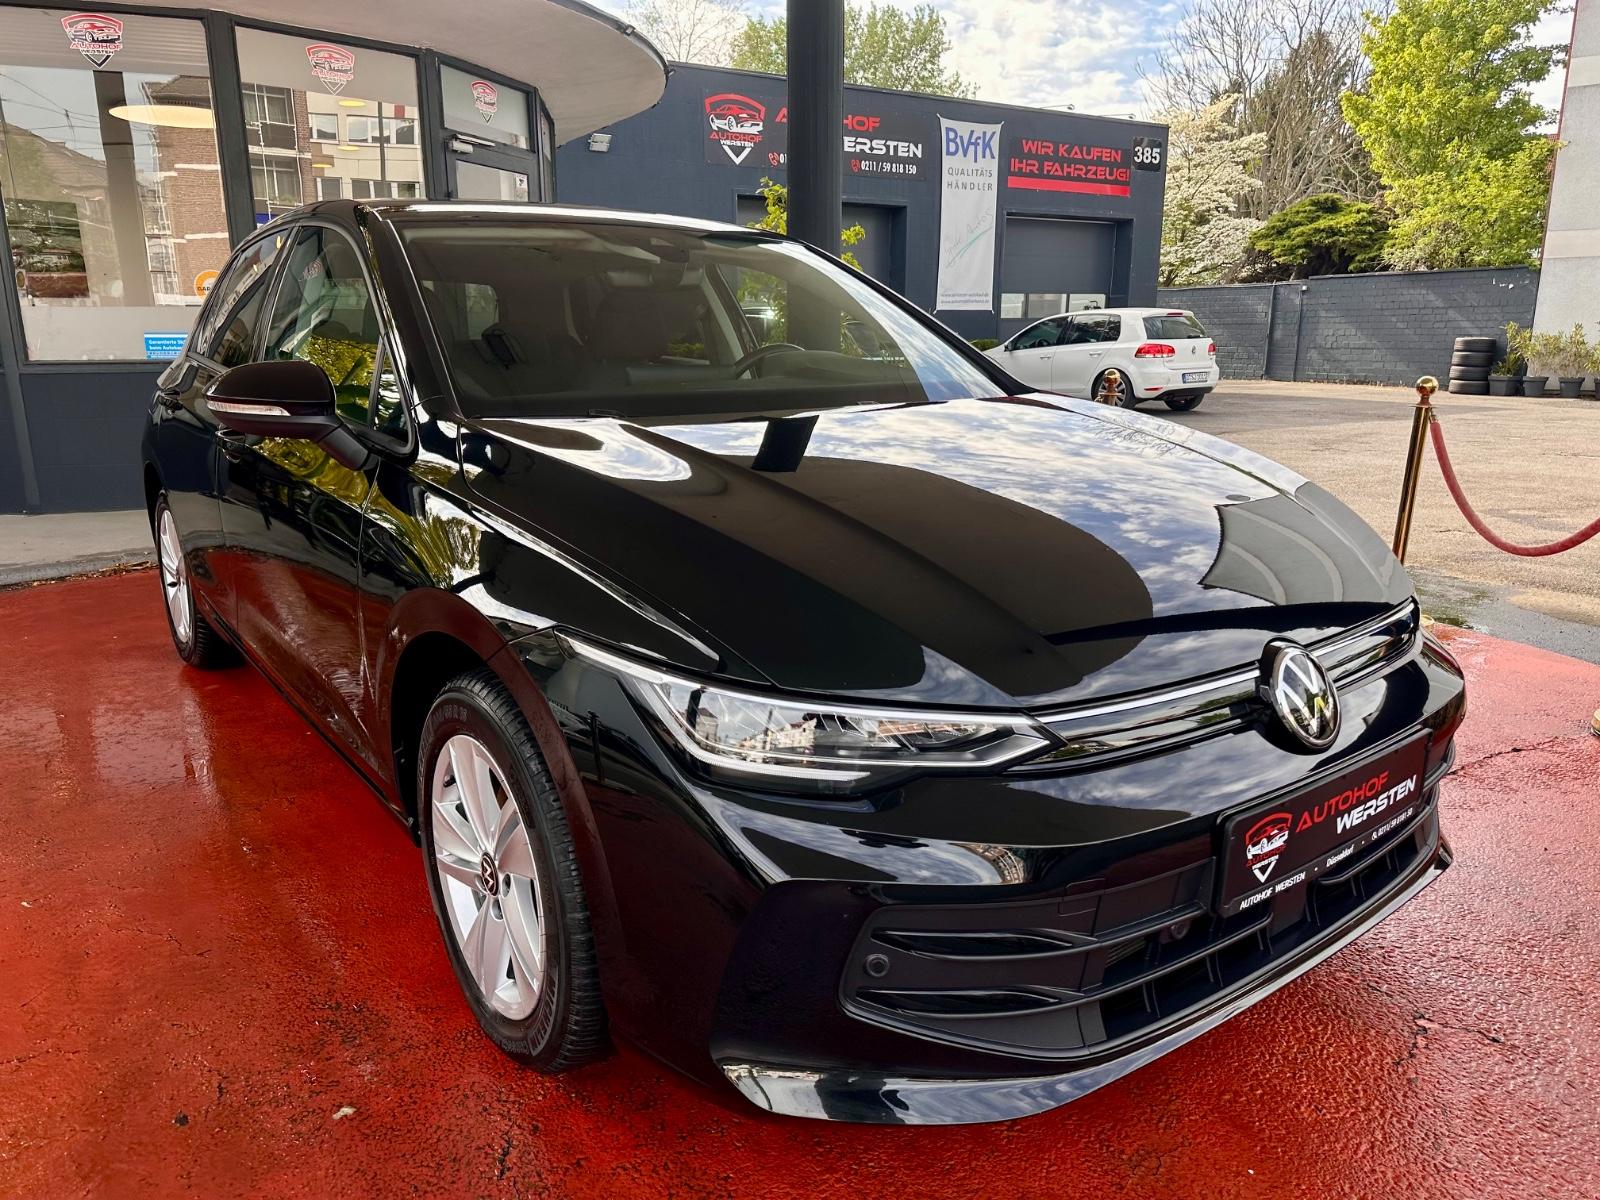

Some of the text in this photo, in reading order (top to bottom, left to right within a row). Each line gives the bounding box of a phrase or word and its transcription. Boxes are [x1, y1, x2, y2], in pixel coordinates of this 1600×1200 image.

[70, 42, 123, 51] AUTOHOF
[709, 131, 763, 142] AUTOHOF
[720, 139, 754, 148] WERSTEN
[843, 136, 922, 158] ERSTEN
[1022, 139, 1122, 163] WIR KAUFEN
[1133, 146, 1161, 164] 385
[861, 160, 876, 171] 0211
[883, 162, 891, 172] 59
[892, 163, 904, 173] 818
[905, 164, 917, 175] 150
[947, 167, 993, 178] QUALITÄTS
[1010, 158, 1130, 181] IHR FAHRZEUG!
[946, 179, 993, 191] HÄNDLER
[1296, 770, 1389, 833] AUTOHOF
[1336, 774, 1417, 834] WERSTEN
[1246, 843, 1287, 868] AUTOHOF
[1239, 871, 1307, 911] AUTOHOF WERSTEN
